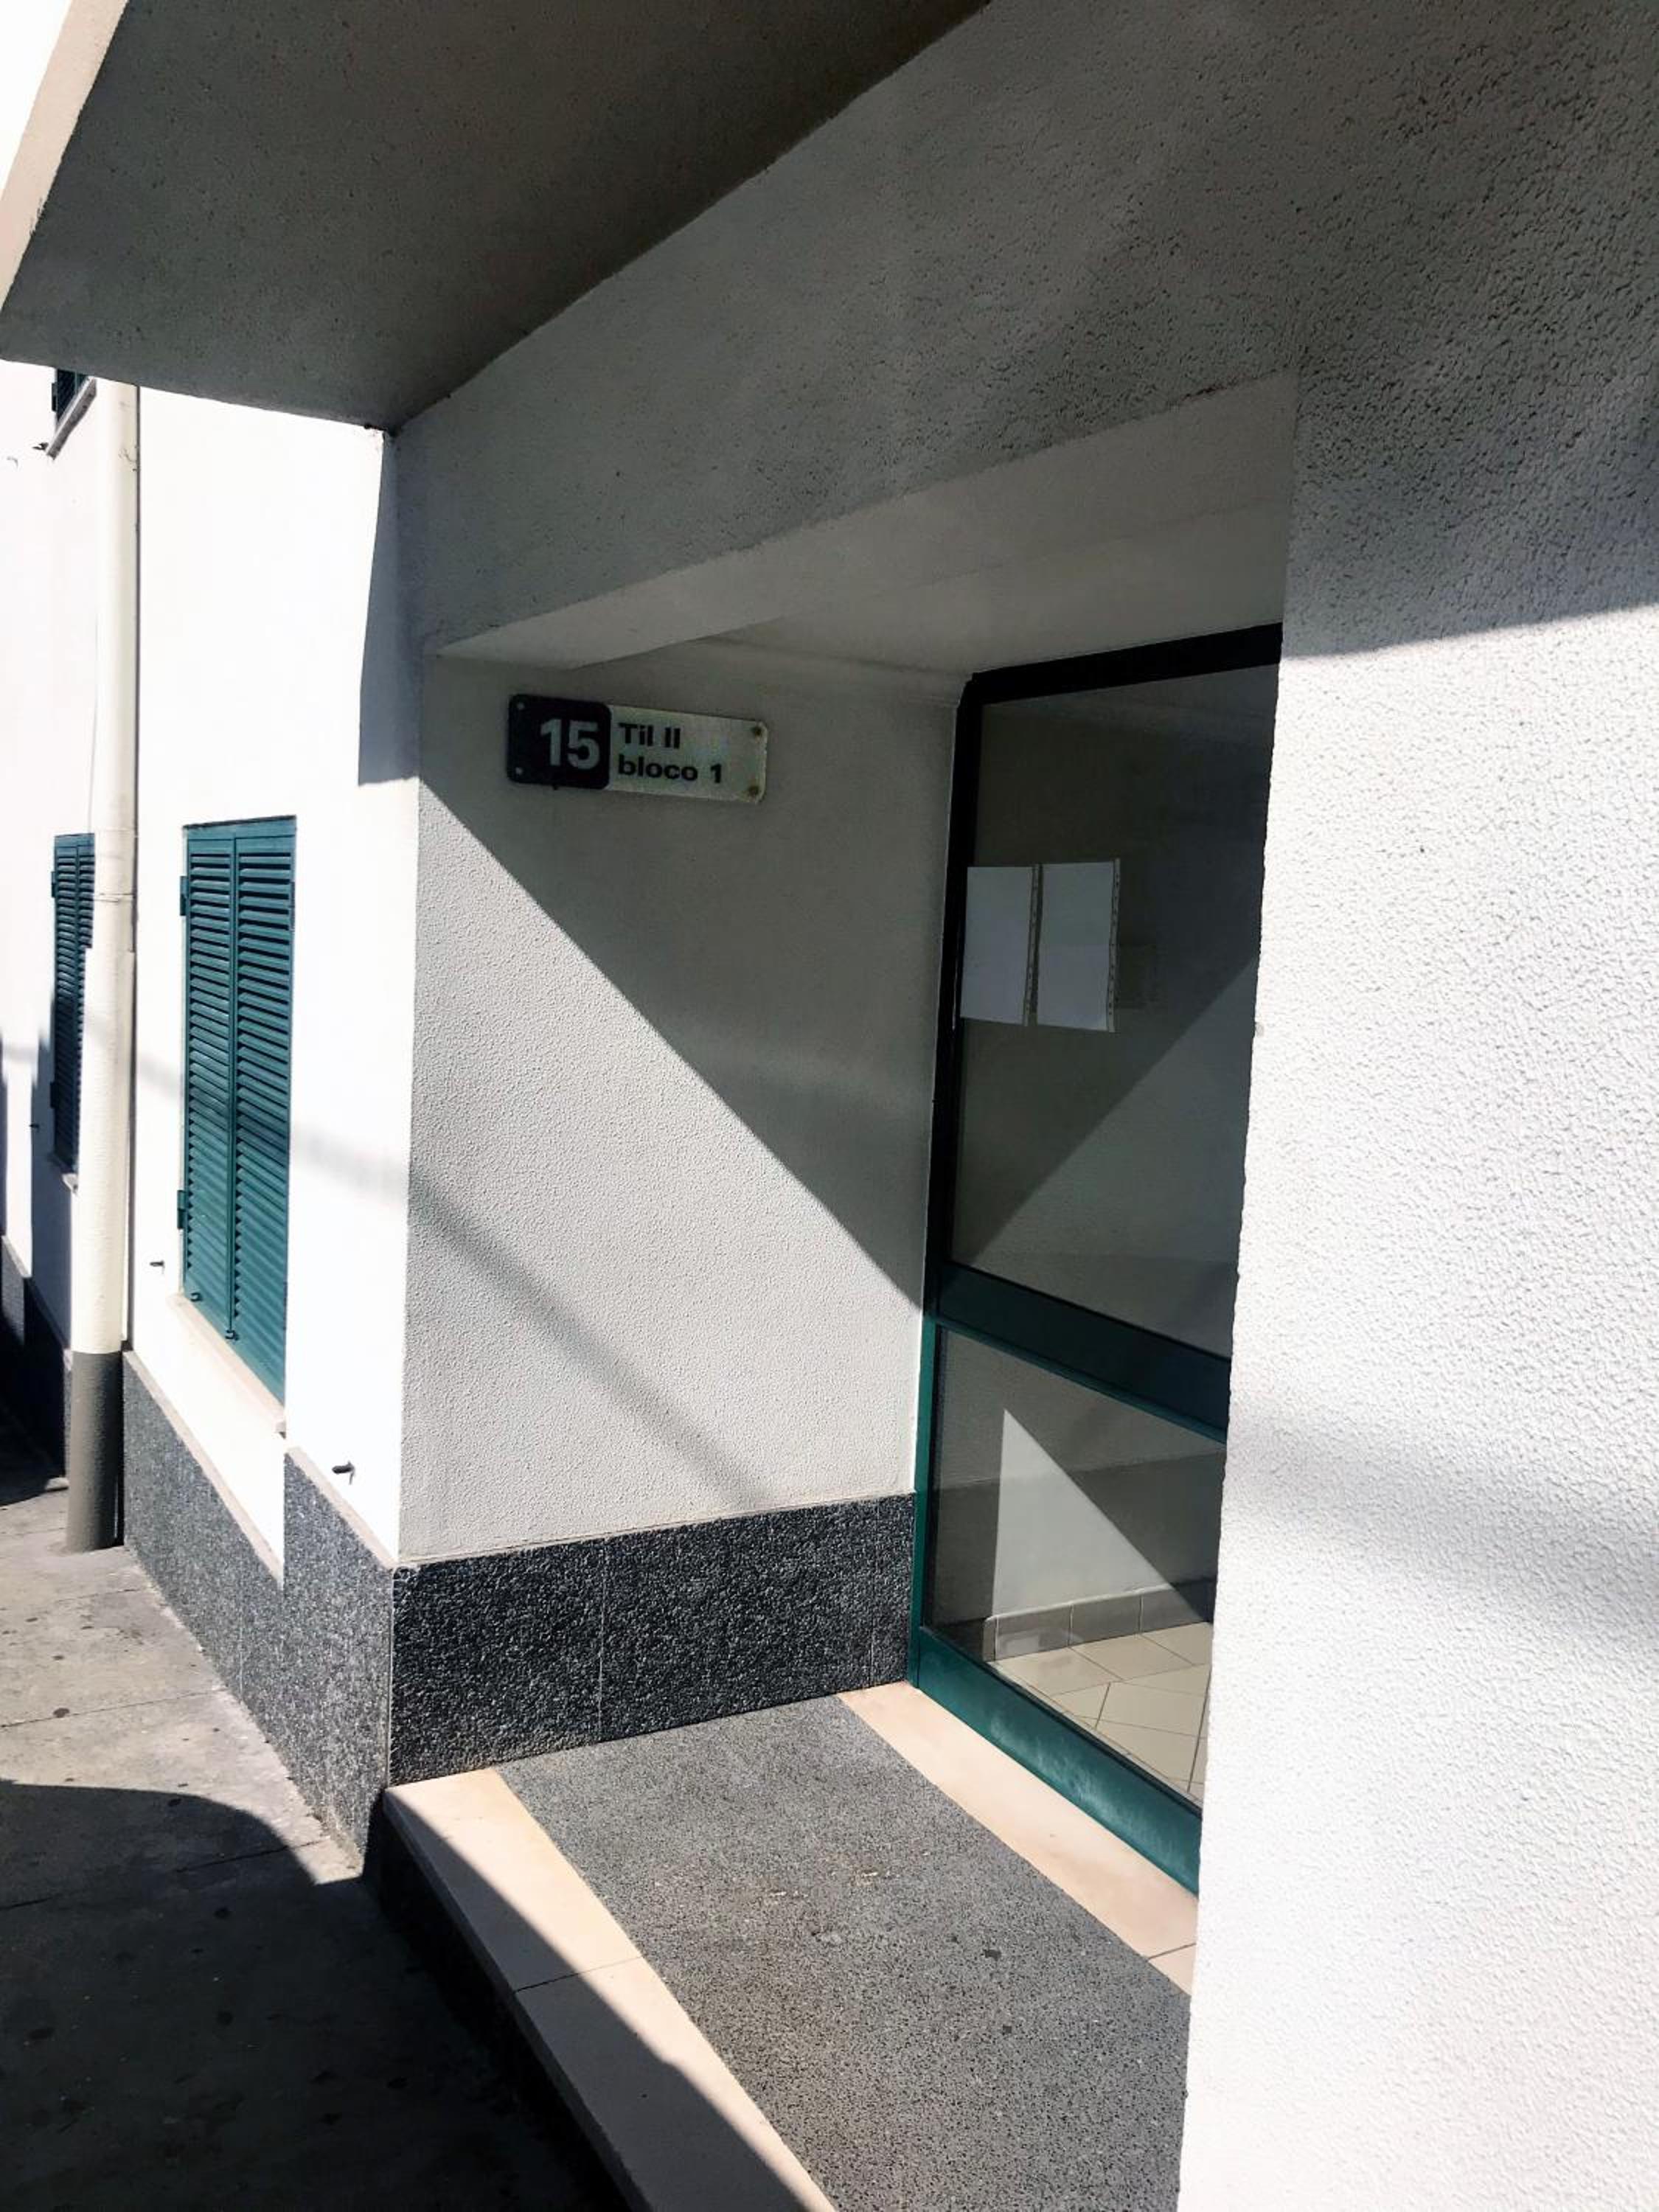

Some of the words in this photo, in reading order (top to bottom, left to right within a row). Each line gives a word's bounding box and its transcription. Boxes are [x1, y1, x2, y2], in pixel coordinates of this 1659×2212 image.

[540, 718, 600, 771] 15
[618, 723, 654, 746] Til
[618, 754, 698, 781] bloco
[710, 763, 723, 784] 1
